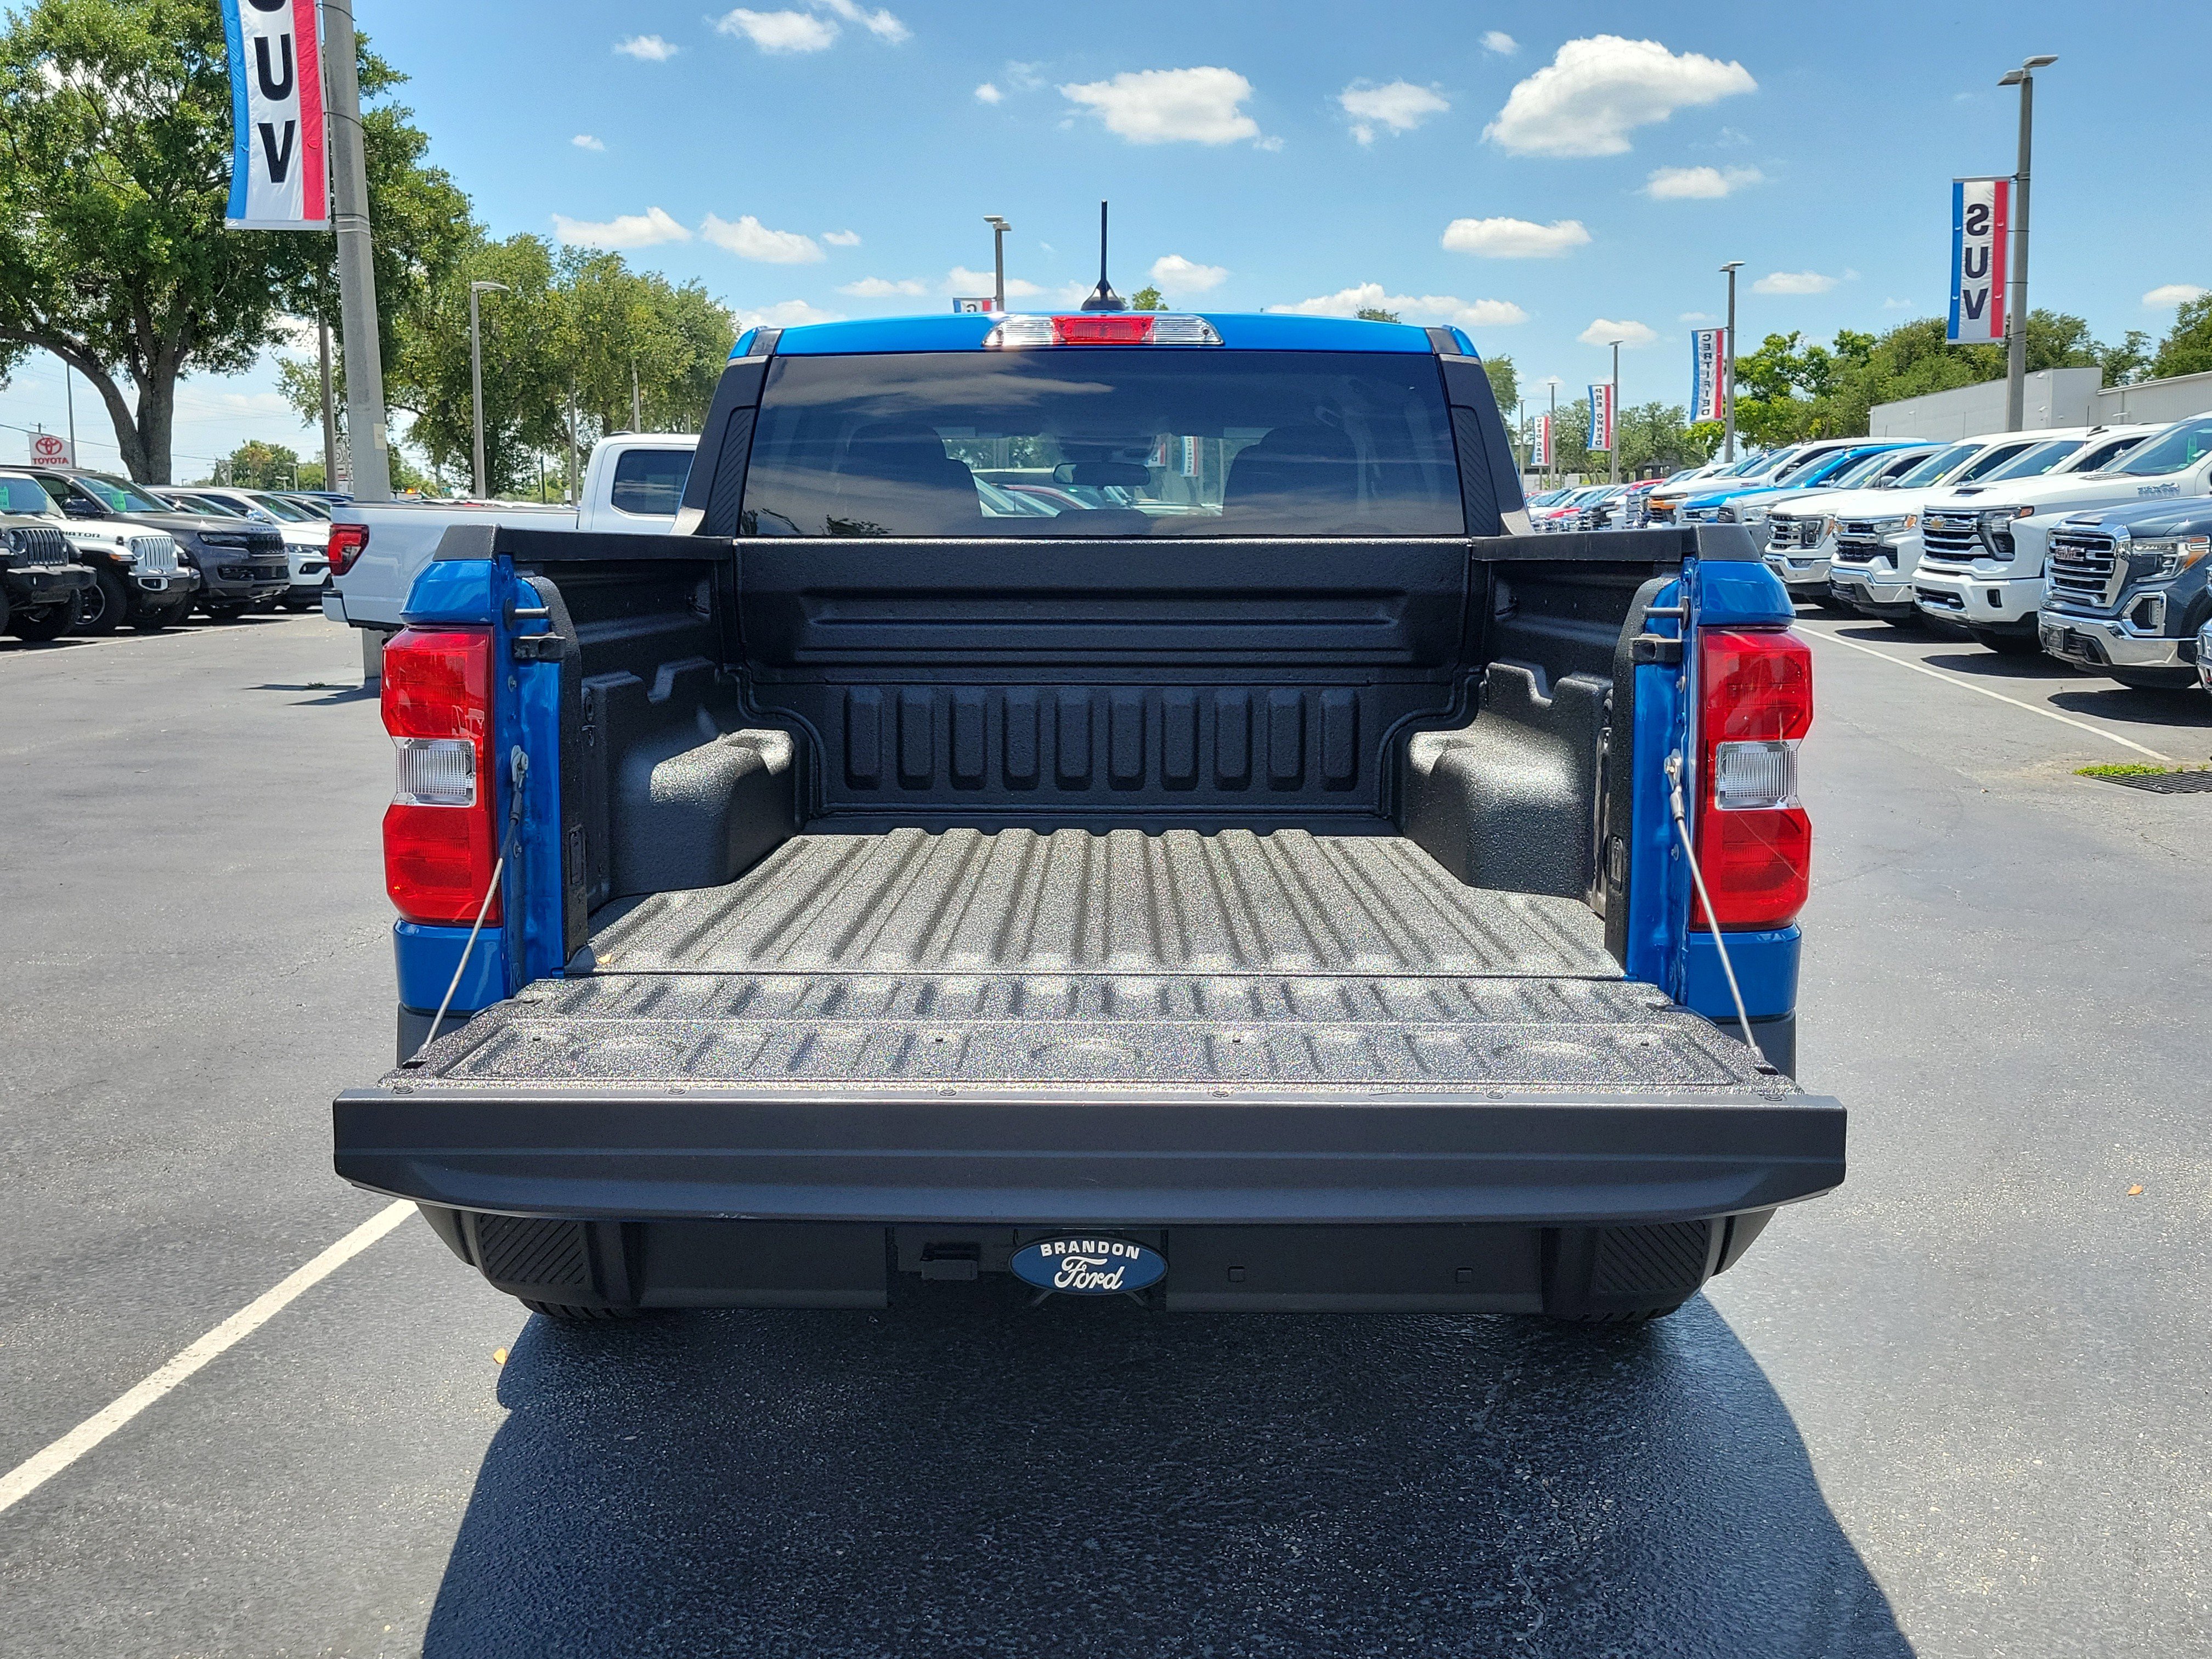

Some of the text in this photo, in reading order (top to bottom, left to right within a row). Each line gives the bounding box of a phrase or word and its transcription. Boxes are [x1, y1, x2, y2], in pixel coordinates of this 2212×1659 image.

[249, 0, 296, 183] UV
[2055, 545, 2085, 561] GMC
[1040, 1240, 1140, 1260] BRANDON
[1054, 1256, 1125, 1289] Ford
